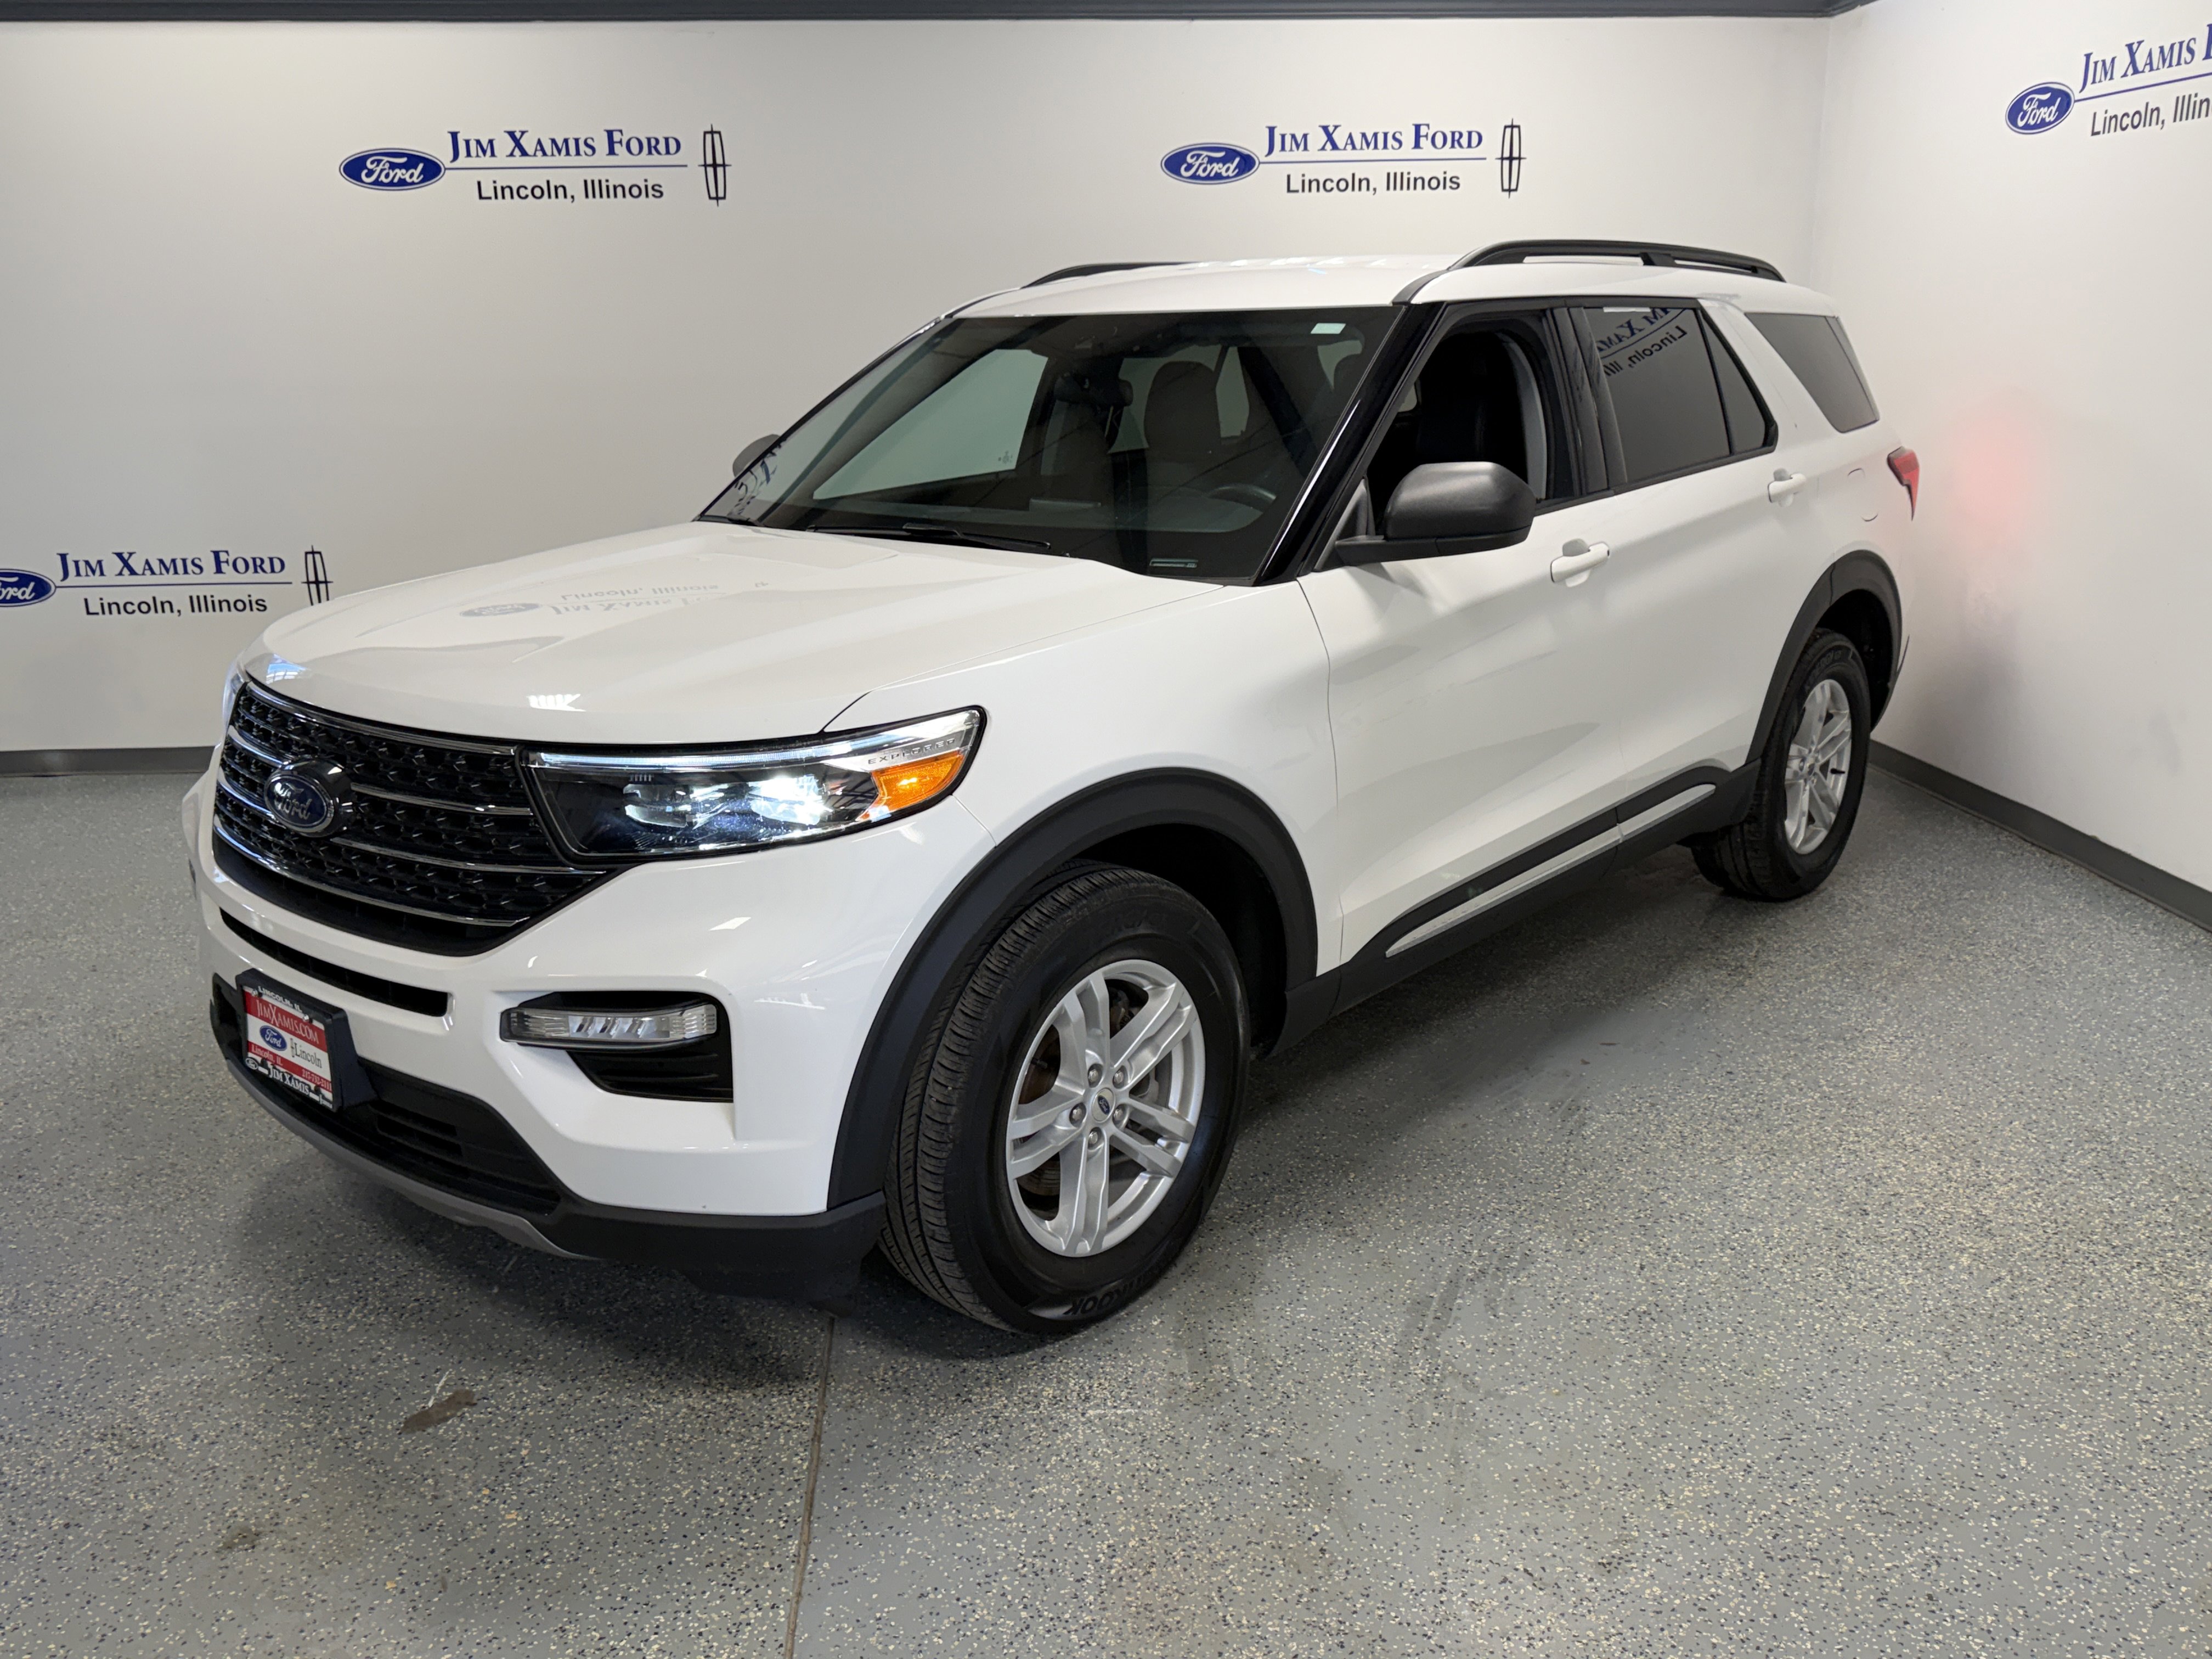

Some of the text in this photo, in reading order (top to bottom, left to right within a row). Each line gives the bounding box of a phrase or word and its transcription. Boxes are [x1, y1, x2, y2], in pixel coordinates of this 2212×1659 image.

[2079, 52, 2117, 94] JIM
[2120, 37, 2197, 78] XAMIS
[2017, 92, 2062, 126] Ford
[2091, 92, 2212, 137] Lincoln, Illin
[448, 129, 681, 163] JIM XAMIS FORD
[1265, 123, 1483, 157] JIM XAMIS FORD
[360, 156, 424, 183] Ford
[1180, 150, 1240, 177] Ford
[477, 178, 664, 203] Lincoln, Illinois
[1286, 171, 1460, 195] Lincoln, Illinois
[57, 550, 285, 582] JIM XAMIS FORD
[83, 594, 267, 617] Lincoln, Illinois
[868, 737, 955, 765] EXPLORER
[265, 1029, 322, 1068] Ford Lincoln
[269, 1066, 311, 1096] JIM XAMIS
